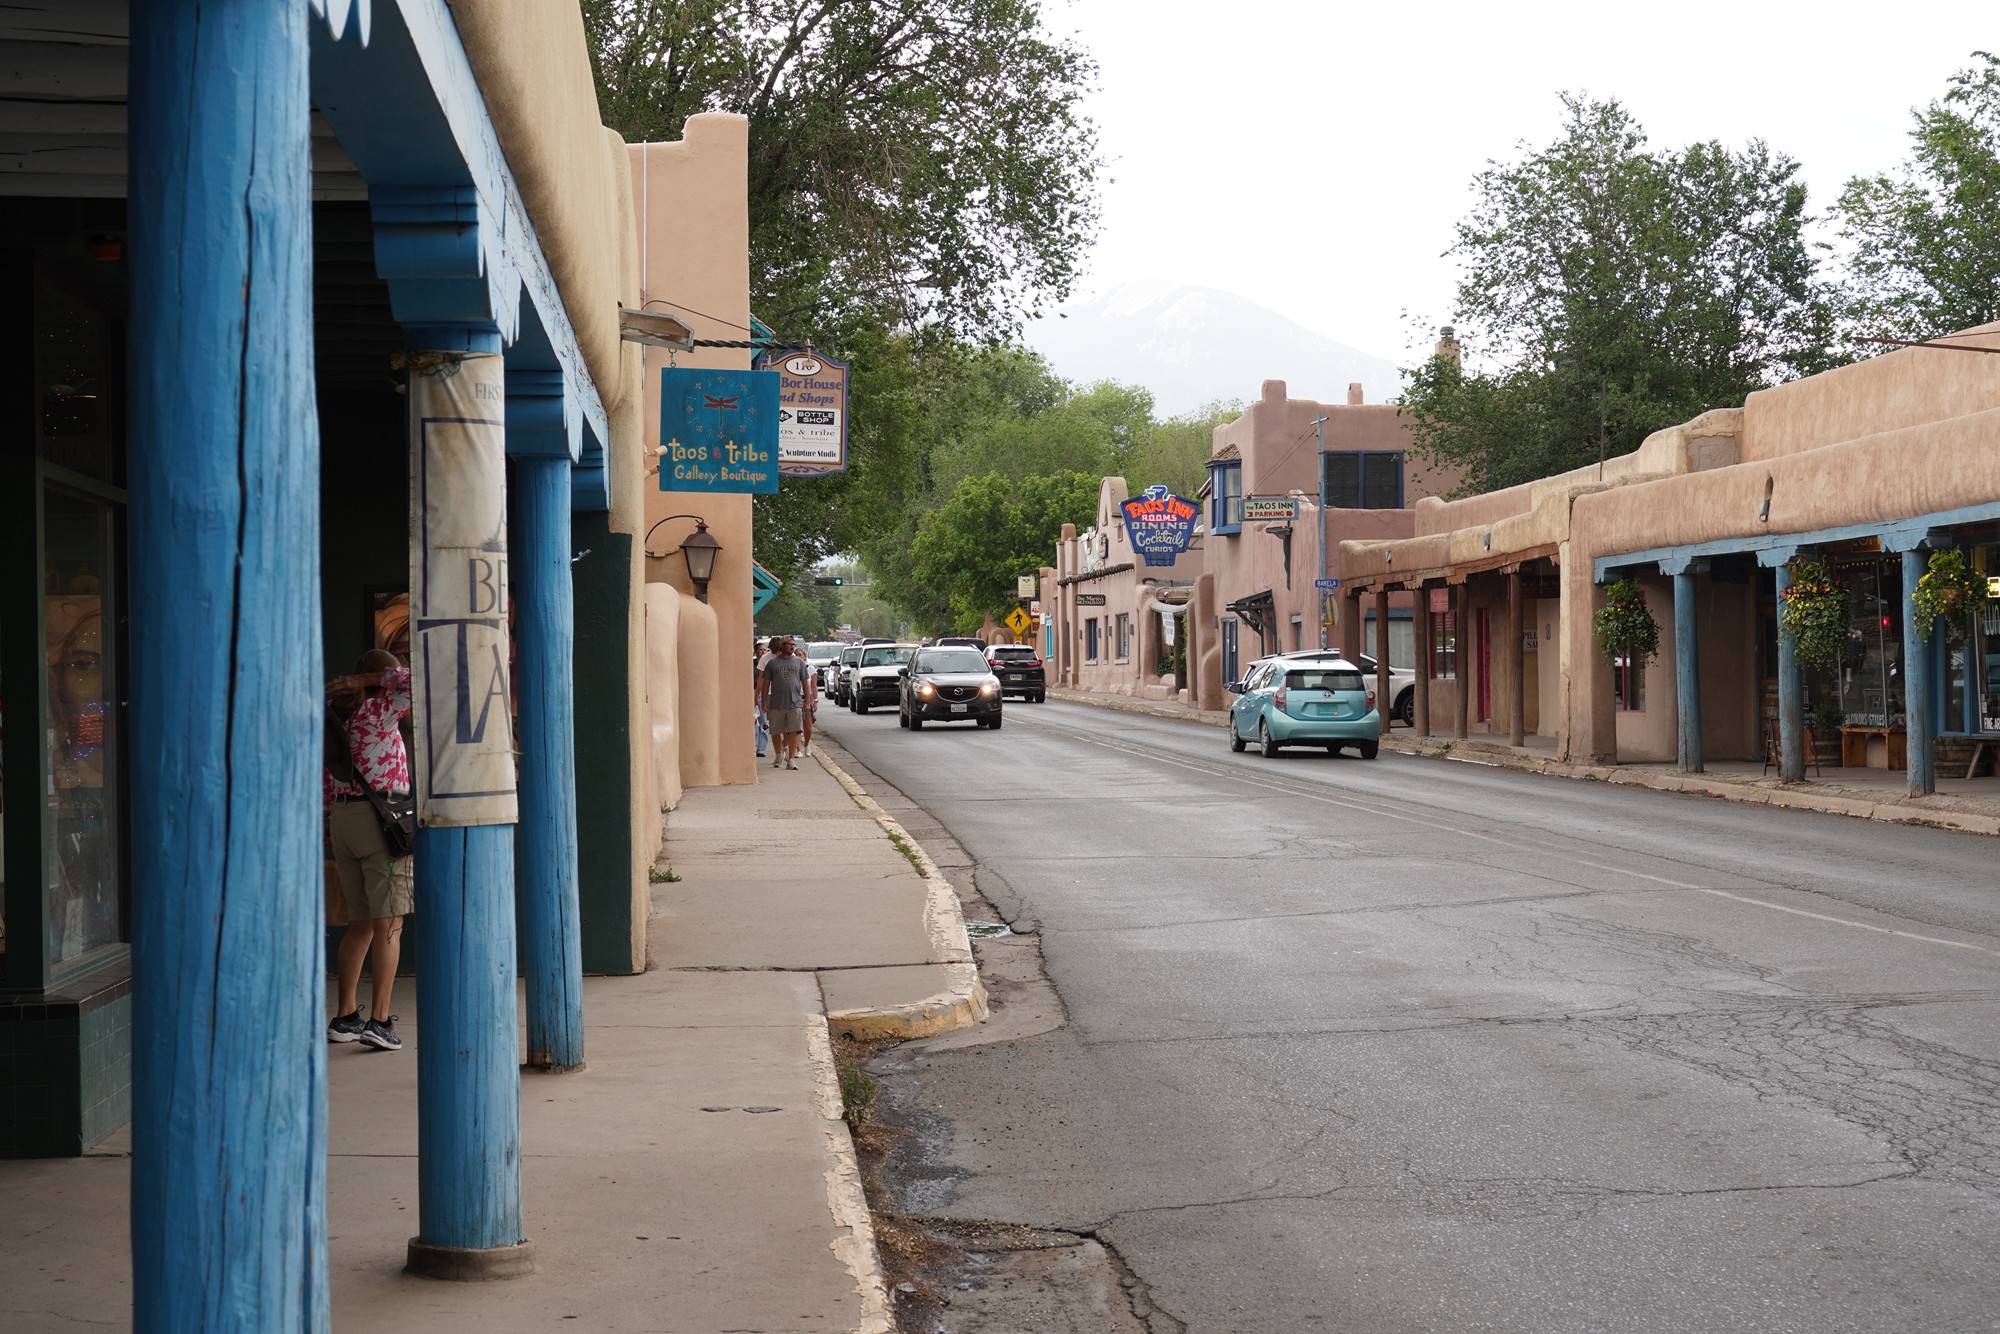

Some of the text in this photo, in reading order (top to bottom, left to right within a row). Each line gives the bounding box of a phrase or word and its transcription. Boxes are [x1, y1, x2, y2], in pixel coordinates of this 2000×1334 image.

[804, 377, 842, 389] House
[798, 393, 835, 406] Shops
[810, 429, 835, 437] tribe
[668, 438, 708, 462] taos
[713, 447, 721, 458] &
[725, 440, 768, 464] tribe
[786, 449, 816, 457] Sculpture
[674, 465, 767, 486] Gallery Boutique
[1125, 497, 1195, 520] TAOS INN
[1254, 502, 1276, 510] TAOS
[1131, 521, 1188, 530] DINING
[1135, 530, 1184, 548] Cocktails
[417, 619, 512, 750] TA
